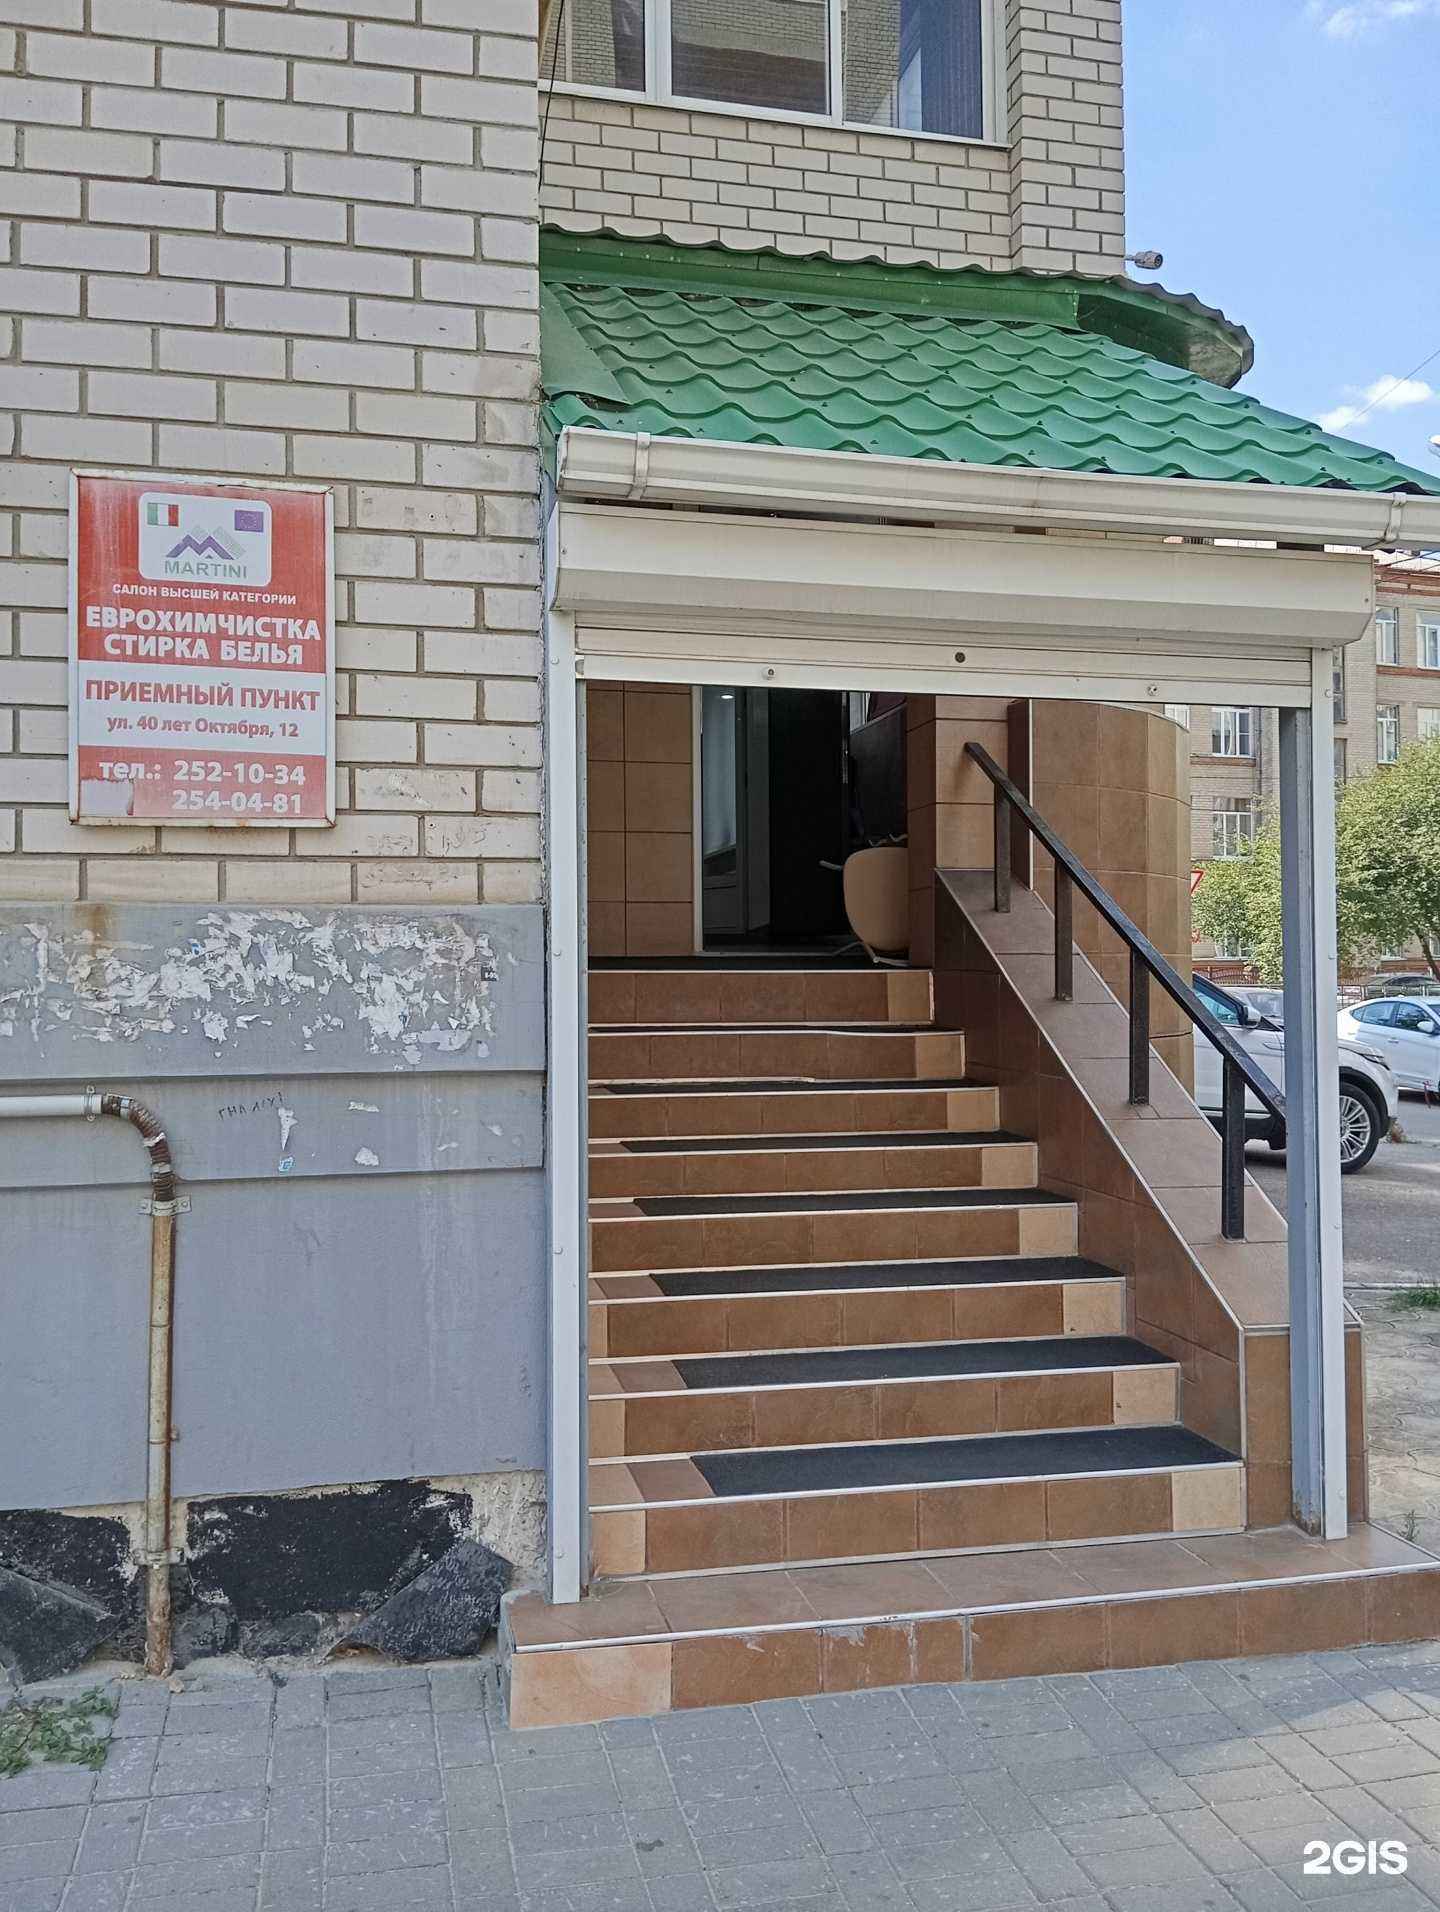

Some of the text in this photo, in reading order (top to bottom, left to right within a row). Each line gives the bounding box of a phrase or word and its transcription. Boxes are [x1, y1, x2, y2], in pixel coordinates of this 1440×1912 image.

[164, 560, 247, 579] MARTINI
[113, 584, 296, 605] САЛОН ВЫСШЕЙ КАТЕГОРИИ
[86, 606, 321, 641] ЕВРОХИМЧИСТКА
[104, 634, 303, 665] СТИРКА БЕЛЬЯ
[86, 679, 320, 711] ПРИЕМНЫЙ ПУНКТ
[107, 716, 299, 739] ул. 40 лет Октября, 12
[99, 760, 306, 785] тел.: 252-10-34
[172, 789, 302, 814] 254-04-81
